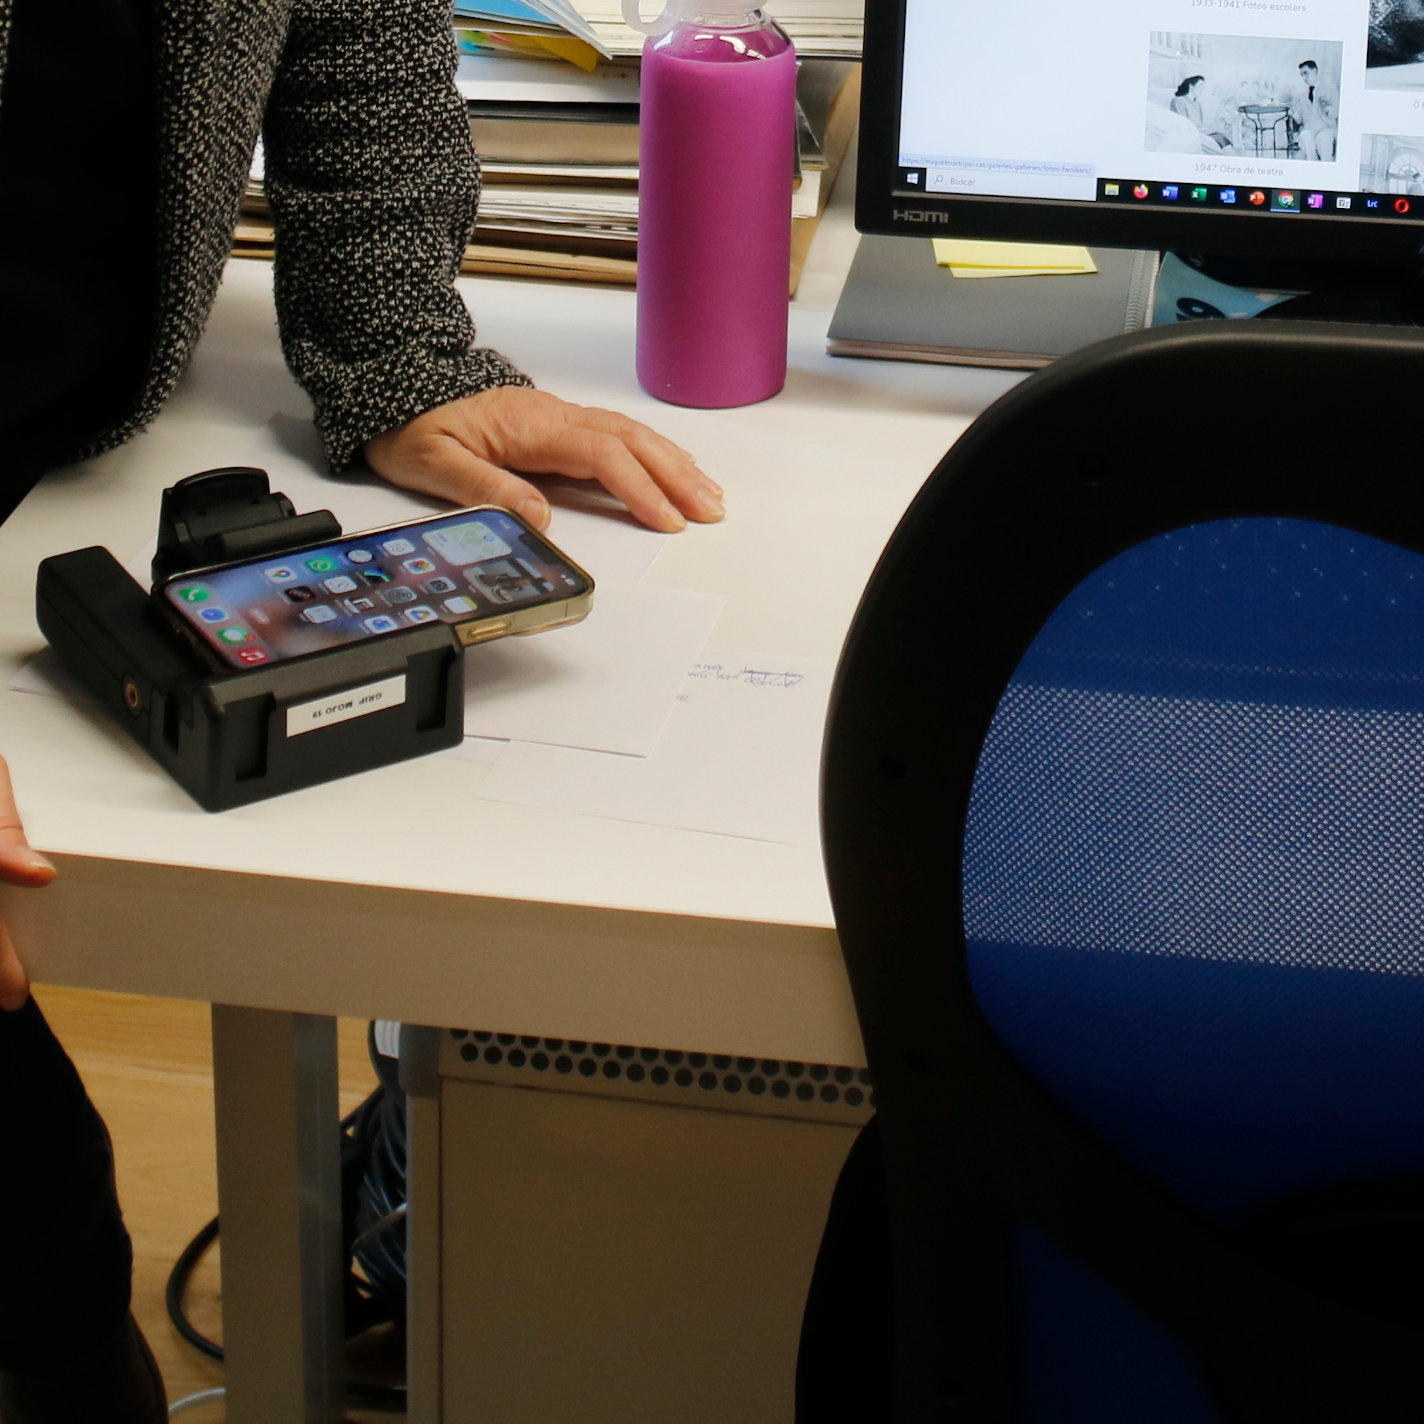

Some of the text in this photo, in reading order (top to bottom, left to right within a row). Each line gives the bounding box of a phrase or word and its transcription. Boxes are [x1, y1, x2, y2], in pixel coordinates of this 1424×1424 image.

[1242, 1, 1268, 11] Fotos
[1269, 2, 1307, 13] escolars
[1413, 101, 1420, 109] 0
[1194, 163, 1284, 177] 1947 Obra de teatre
[949, 176, 976, 187] Buscar
[892, 209, 950, 225] HDMI
[358, 692, 383, 706] GRIP
[325, 700, 354, 715] MOJO
